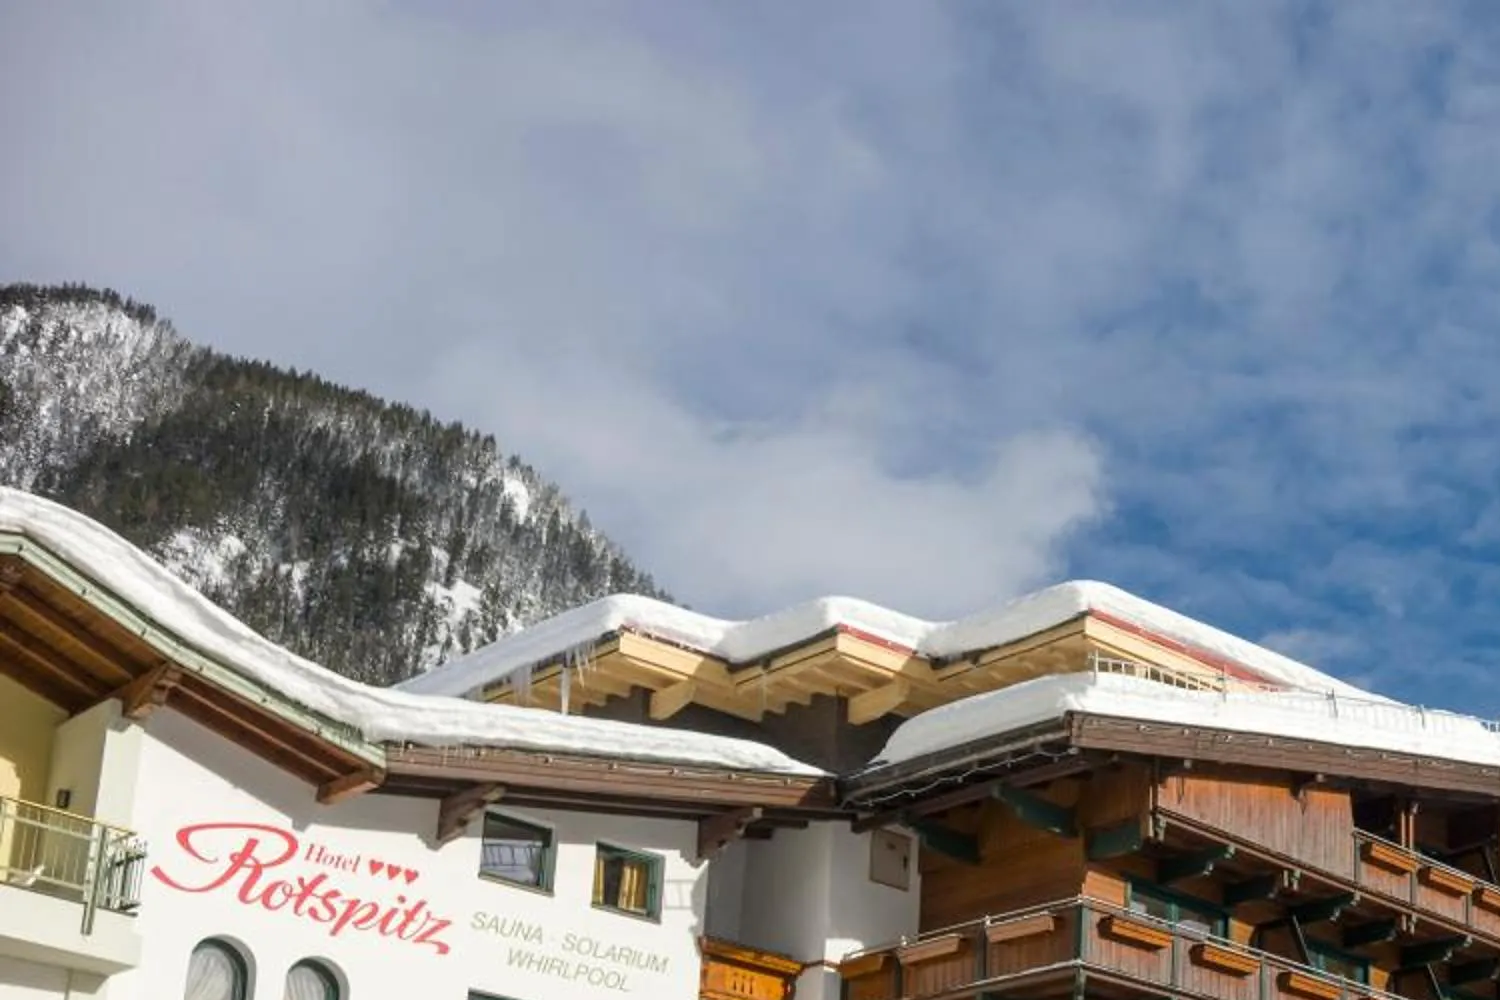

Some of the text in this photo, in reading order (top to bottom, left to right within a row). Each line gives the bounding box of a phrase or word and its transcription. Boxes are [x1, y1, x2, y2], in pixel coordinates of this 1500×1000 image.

[303, 842, 361, 874] Hotel
[151, 822, 453, 955] Rotspitz
[470, 911, 670, 974] SAUNA SOLARIUM
[506, 948, 632, 993] WHIRLPOOL
